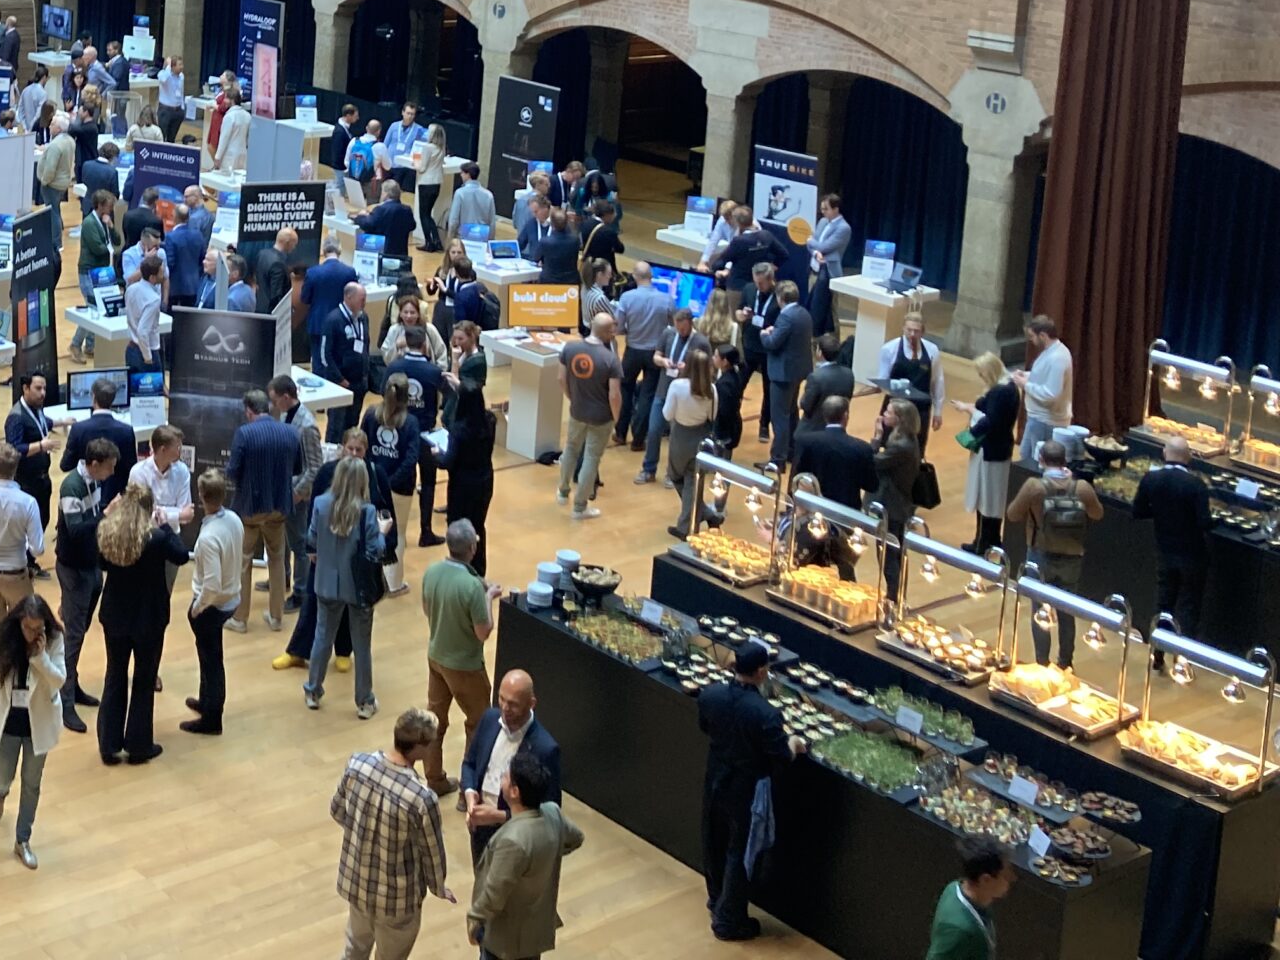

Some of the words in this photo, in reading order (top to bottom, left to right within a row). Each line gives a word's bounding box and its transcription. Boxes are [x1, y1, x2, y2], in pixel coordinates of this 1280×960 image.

[151, 151, 186, 164] INTRINSIC
[186, 156, 195, 165] ID
[258, 192, 287, 203] THERE
[288, 192, 298, 202] IS
[298, 192, 307, 202] A
[247, 202, 283, 213] DIGITAL
[283, 201, 316, 211] CLONE
[247, 212, 283, 223] BEHIND
[283, 210, 315, 221] EVERY
[243, 222, 281, 233] HUMAN
